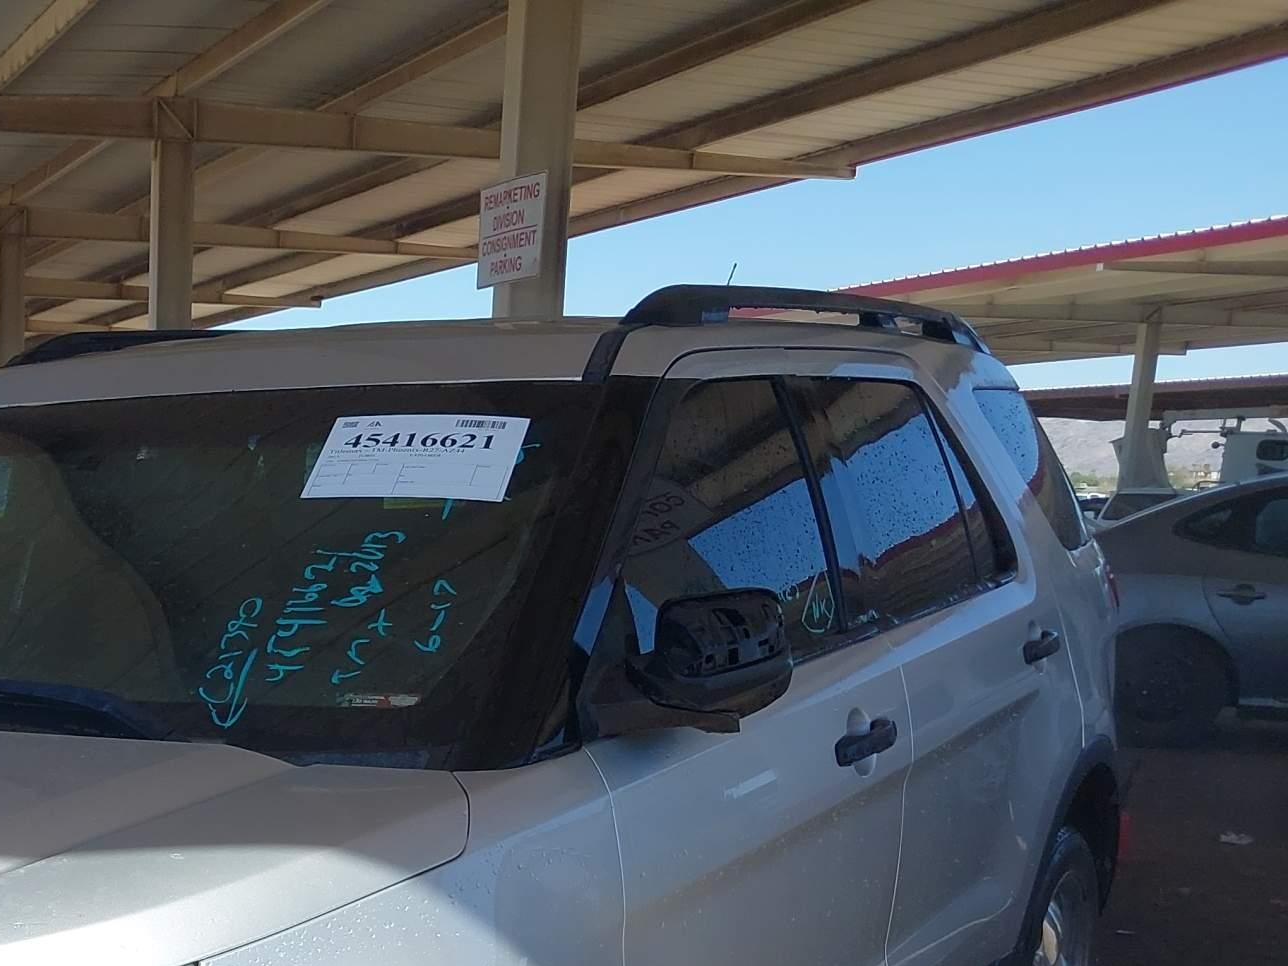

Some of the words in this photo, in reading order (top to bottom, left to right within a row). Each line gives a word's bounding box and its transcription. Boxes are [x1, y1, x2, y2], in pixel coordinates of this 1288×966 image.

[484, 181, 541, 211] REMARKETING
[492, 208, 526, 232] DIVISION
[481, 229, 538, 257] CONSIGNMENT
[489, 255, 523, 277] PARKING
[343, 432, 495, 451] 45416621
